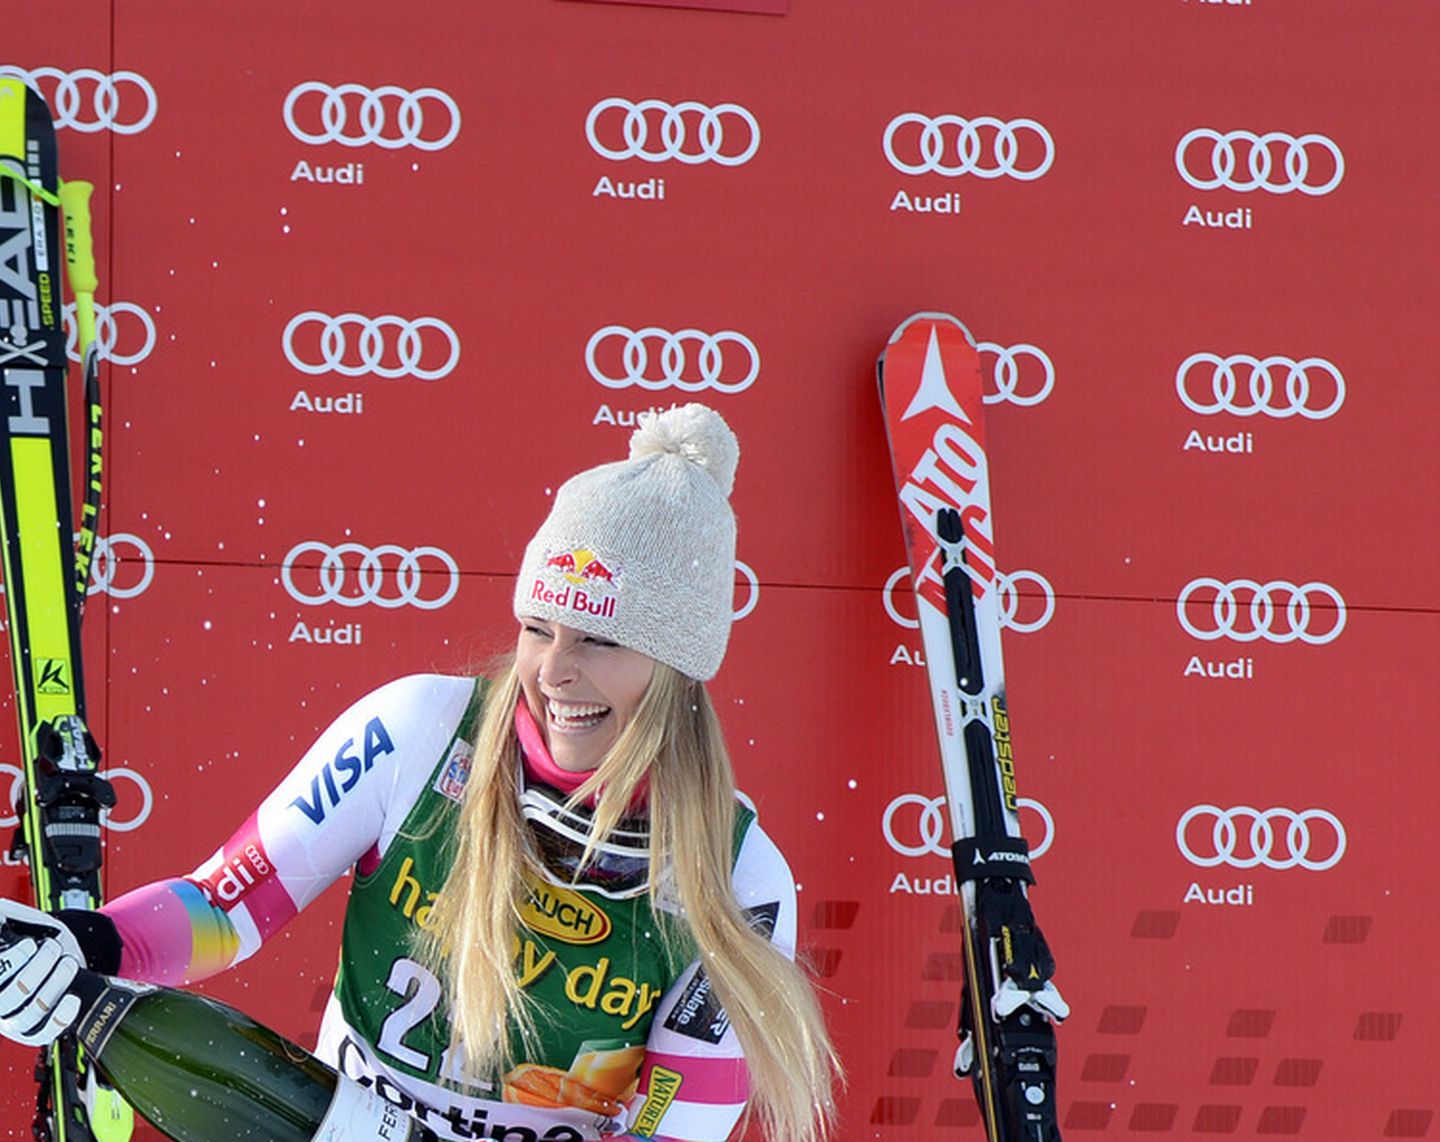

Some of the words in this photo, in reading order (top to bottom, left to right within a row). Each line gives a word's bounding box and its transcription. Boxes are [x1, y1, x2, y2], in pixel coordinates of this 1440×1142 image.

[290, 160, 364, 185] Audi
[592, 175, 665, 200] Audi
[890, 190, 961, 214] Audi
[1182, 205, 1252, 229] Audi
[65, 215, 78, 265] LEKI
[289, 390, 363, 414] Audi
[90, 403, 103, 494] LEKI
[1183, 429, 1253, 454] Audi
[75, 502, 97, 594] LEKI
[531, 579, 571, 607] Red
[572, 590, 616, 618] Bull
[288, 621, 362, 645] Audi
[1183, 656, 1253, 680] Audi
[286, 715, 396, 826] VISA
[1183, 882, 1253, 906] Audi
[524, 888, 596, 936] AUCH
[564, 956, 661, 1030] day
